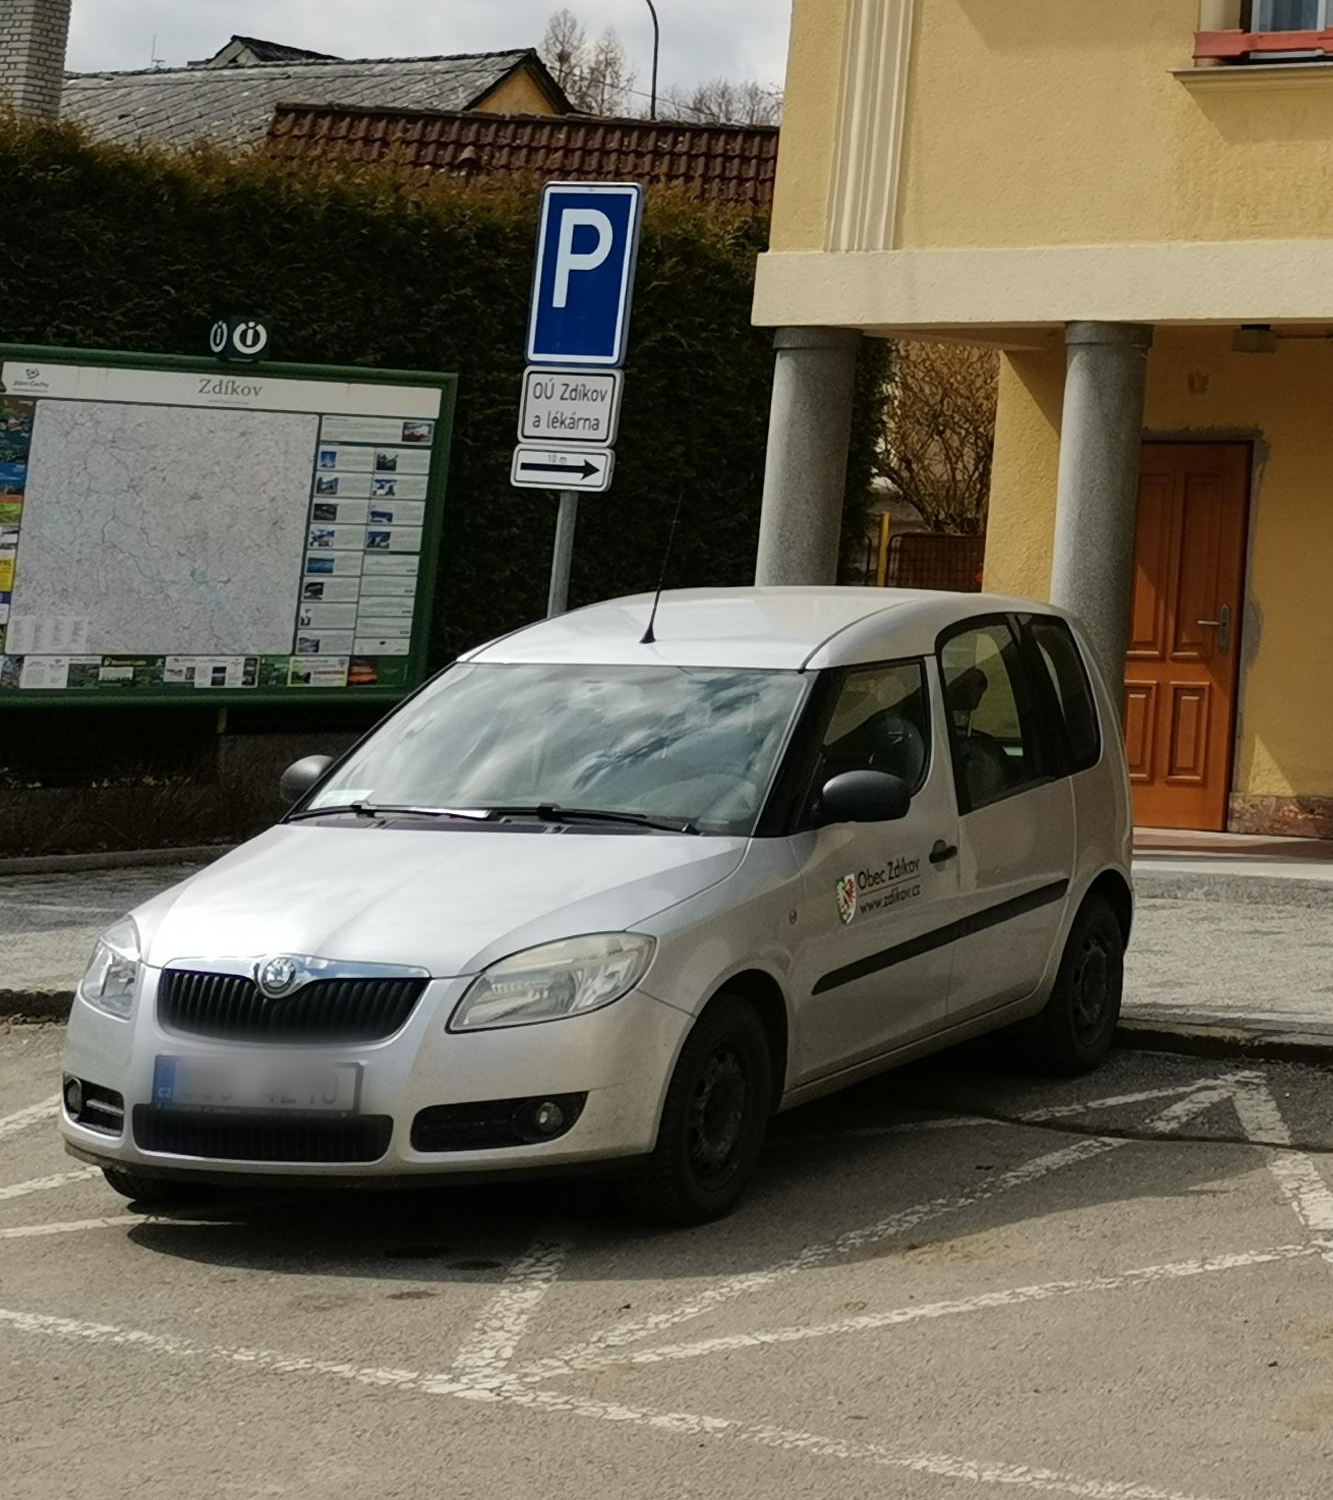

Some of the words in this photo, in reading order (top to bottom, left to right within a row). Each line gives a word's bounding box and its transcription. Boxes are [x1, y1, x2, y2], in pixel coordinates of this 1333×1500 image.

[552, 208, 613, 308] P
[198, 378, 263, 397] Zdíkov
[533, 378, 555, 400] OÚ
[560, 383, 608, 402] Zdíkov
[533, 414, 541, 428] a
[546, 410, 600, 431] lékárna
[857, 867, 886, 890] Obec
